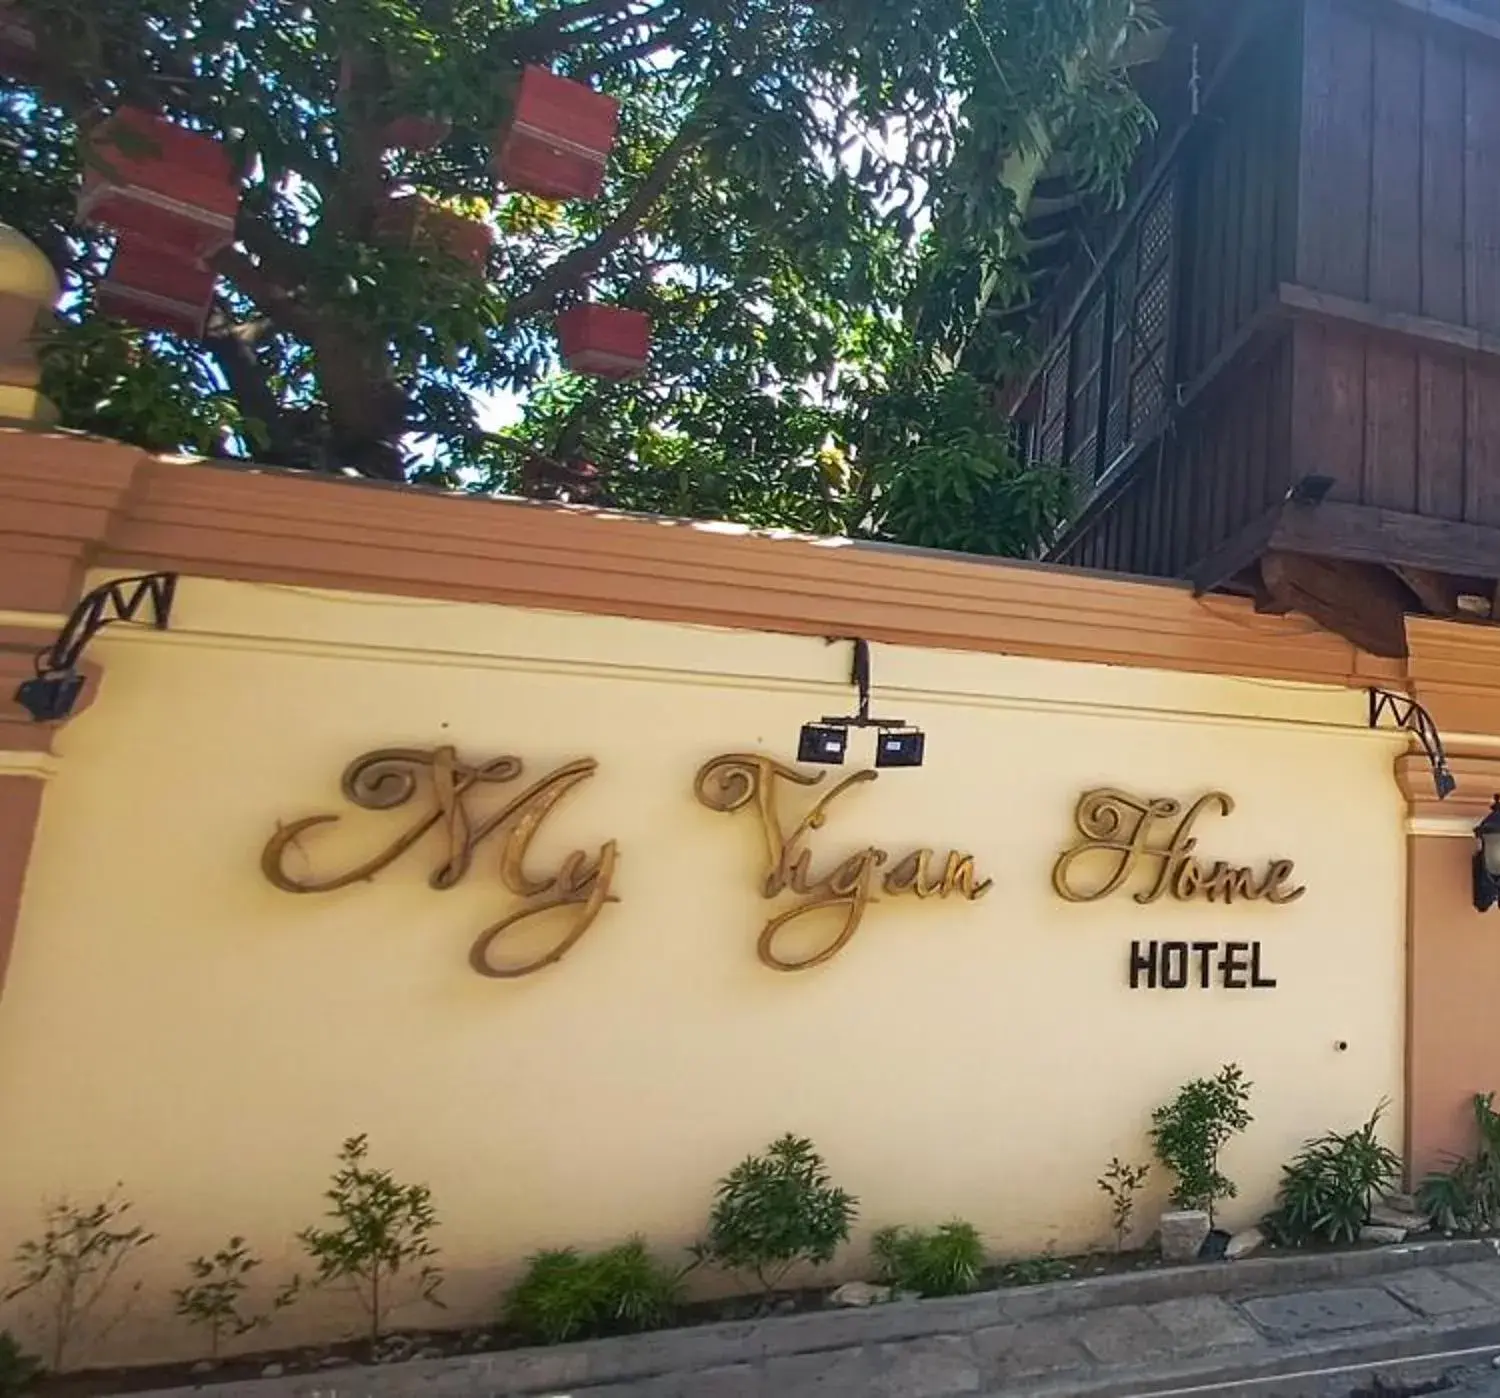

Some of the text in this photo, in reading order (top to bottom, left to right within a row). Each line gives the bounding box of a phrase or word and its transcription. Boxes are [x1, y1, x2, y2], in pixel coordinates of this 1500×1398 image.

[261, 745, 1305, 978] My Vigan Home
[1130, 940, 1277, 988] HOTEL
